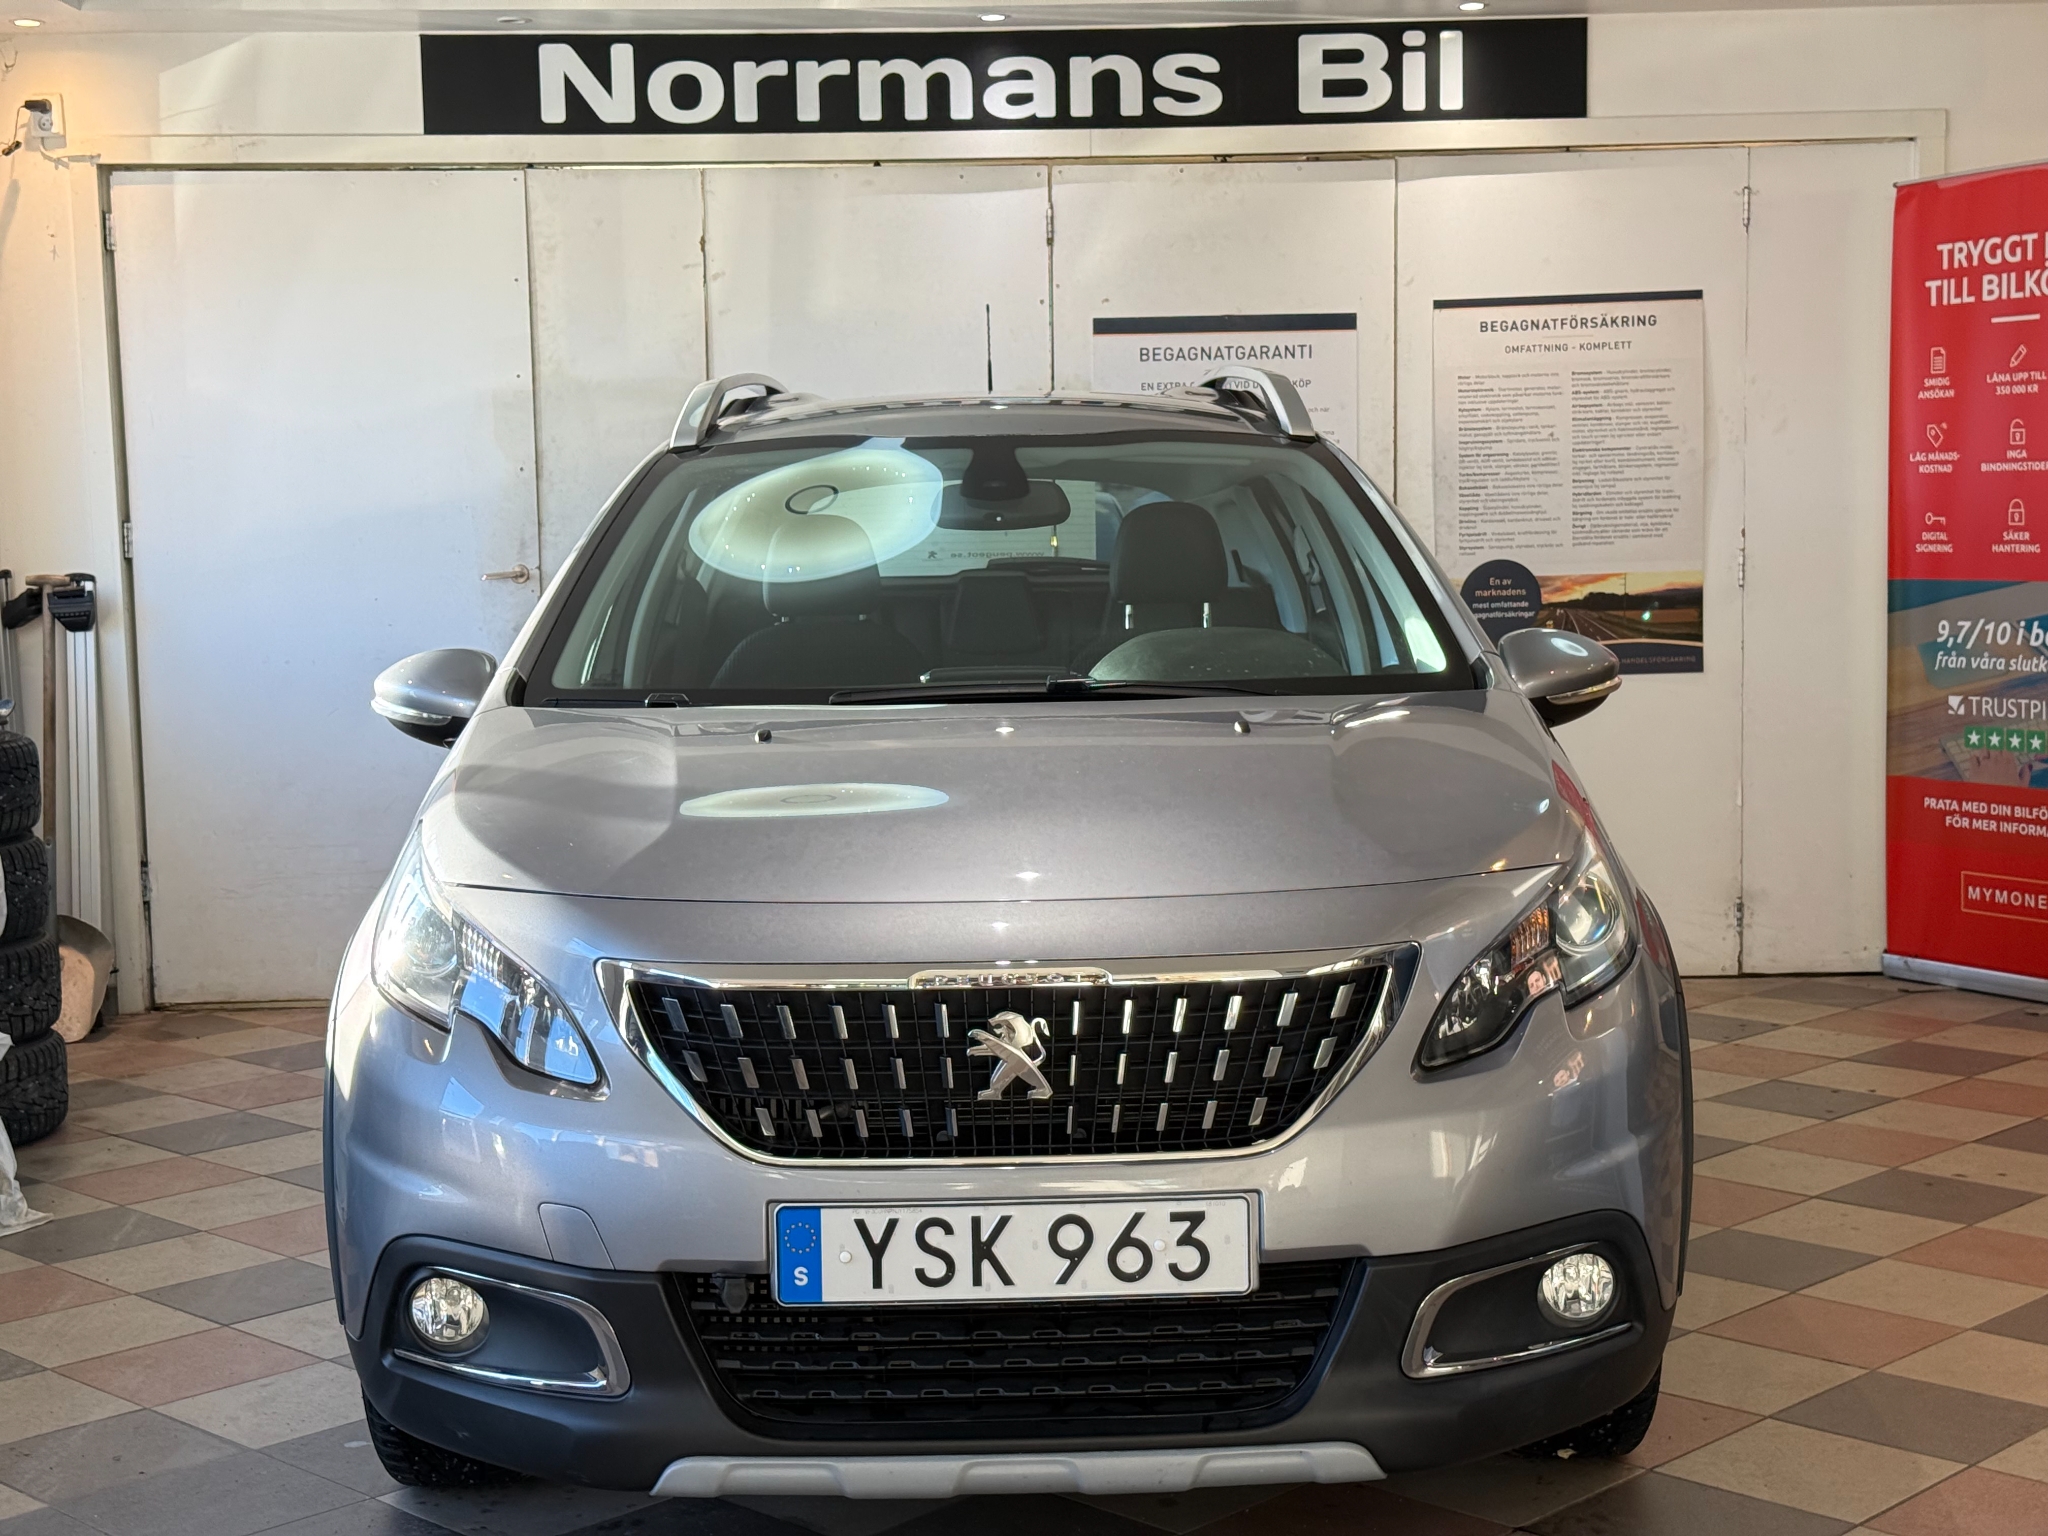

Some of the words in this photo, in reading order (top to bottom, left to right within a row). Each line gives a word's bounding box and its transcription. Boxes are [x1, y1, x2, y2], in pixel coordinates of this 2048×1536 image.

[539, 42, 1224, 125] Norrmans
[1297, 29, 1465, 114] Bil
[1936, 232, 2039, 270] TRYGGT
[1925, 276, 1976, 307] TILL
[1479, 313, 1658, 333] BEGAGNATFÖRSÄKRING
[1139, 344, 1313, 362] BEGAGNATGARANTI
[1504, 343, 1569, 354] OMFATTNING
[1579, 341, 1633, 352] KOMPLETT
[1924, 377, 1950, 387] SMIDIG
[1986, 374, 2010, 383] LÅNA
[2012, 373, 2028, 382] UPP
[2029, 371, 2047, 380] TILL
[1141, 382, 1154, 391] EN
[1234, 380, 1250, 389] VID
[1995, 386, 2010, 395] 350
[2011, 385, 2026, 394] 000
[2027, 384, 2039, 393] KR
[1918, 388, 1954, 399] ANSÖKAN
[1909, 451, 1926, 461] LÅG
[1928, 450, 1960, 461] MÅNADS-
[2006, 449, 2027, 459] INGA
[1919, 464, 1952, 473] KOSTNAD
[1922, 531, 1948, 541] DIGITAL
[2002, 530, 2030, 541] SÄKER
[1915, 543, 1953, 553] SIGNERING
[1992, 544, 2041, 553] HANTERING
[1489, 577, 1501, 586] En
[1475, 588, 1527, 597] marknadens
[1490, 600, 1529, 609] omfattande
[1473, 610, 1536, 620] gagnatförsäkringar
[1936, 618, 2012, 650] 9,7/10
[2016, 620, 2026, 646] i
[1934, 650, 1967, 671] från
[1971, 652, 2006, 670] våra
[1967, 696, 2048, 721] TRUSTPI
[1923, 797, 1960, 812] PRATA
[1962, 801, 1988, 814] MED
[1990, 803, 2011, 817] DIN
[1945, 813, 1970, 828] FÖR
[1972, 818, 1997, 832] MER
[1967, 885, 2048, 910] MYMONE
[853, 1214, 1015, 1289] YSK
[1047, 1210, 1211, 1285] 963
[793, 1266, 809, 1286] S
